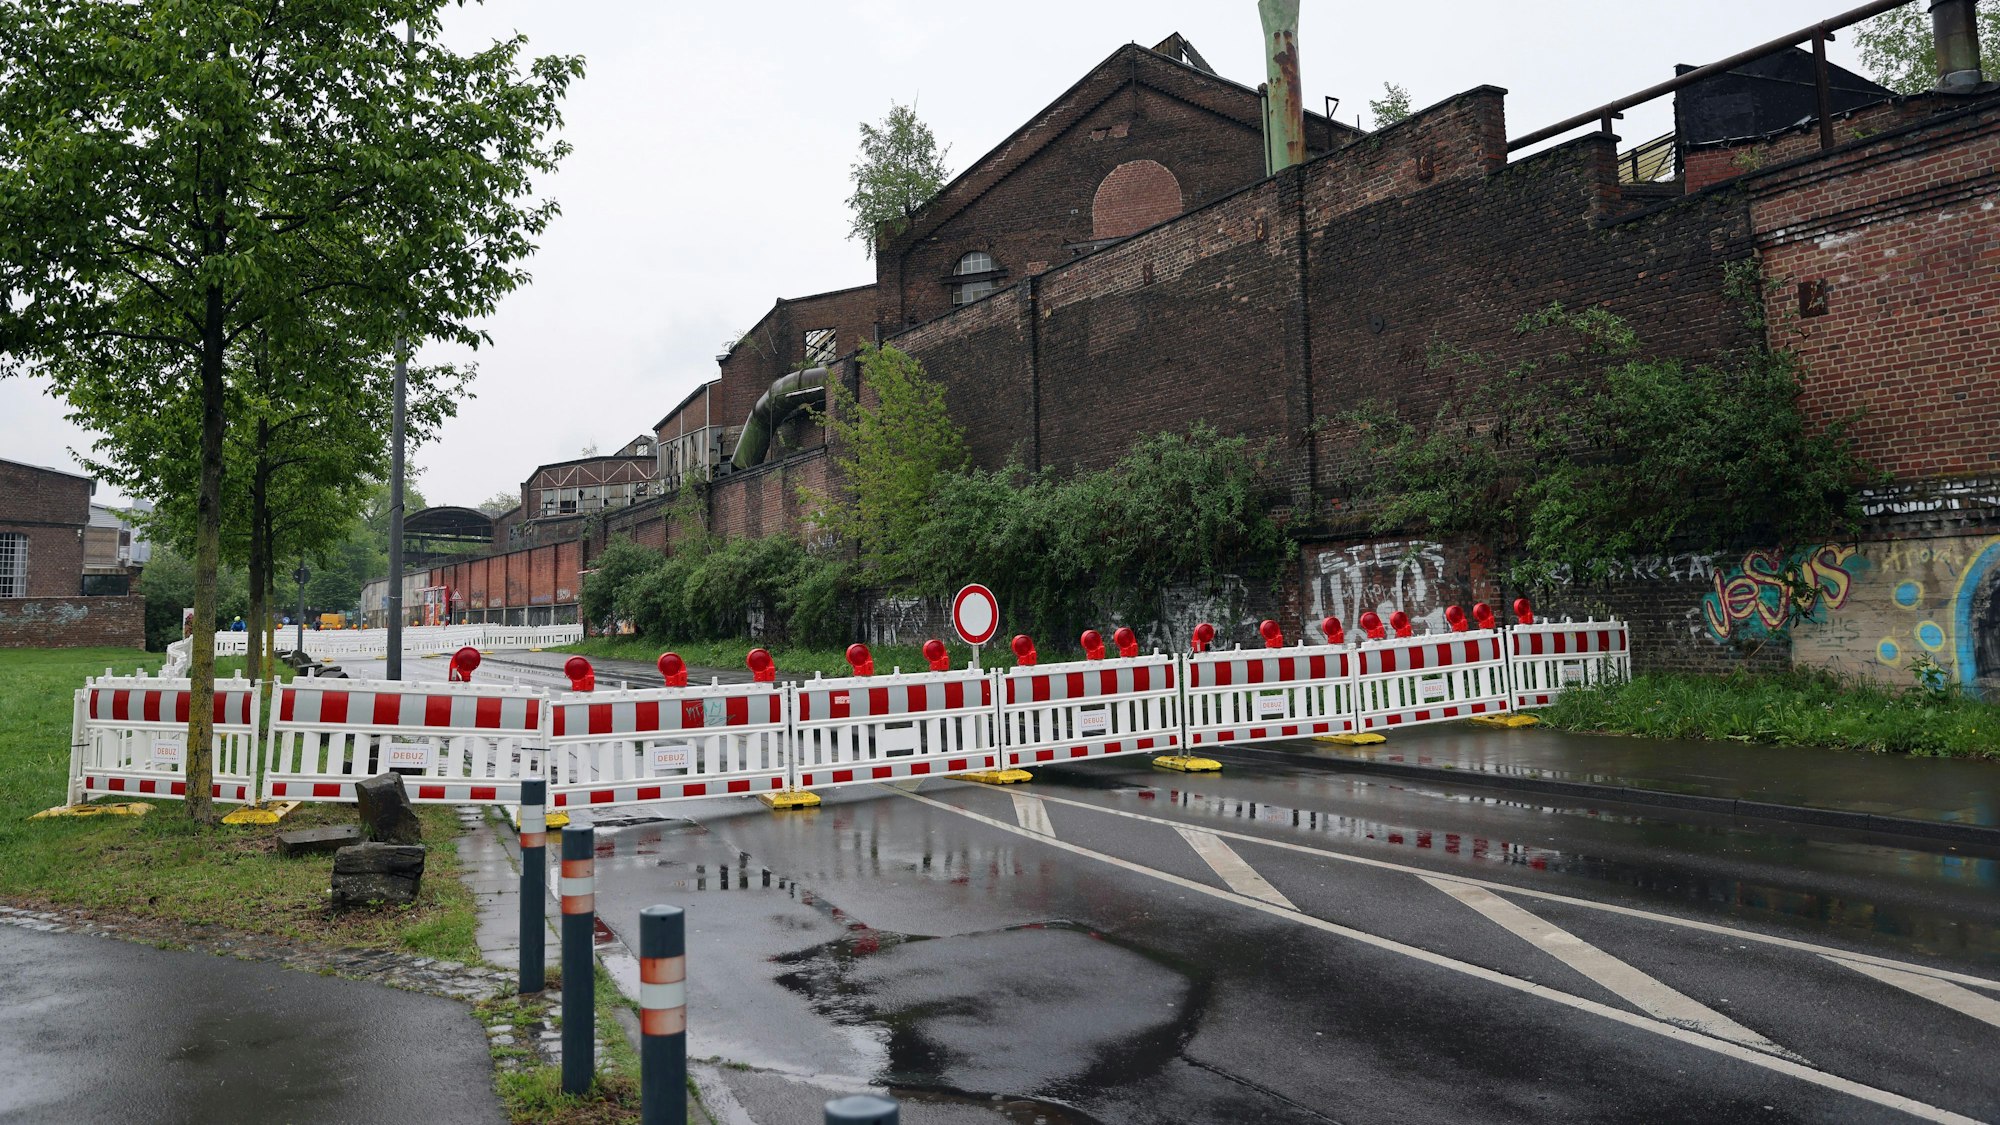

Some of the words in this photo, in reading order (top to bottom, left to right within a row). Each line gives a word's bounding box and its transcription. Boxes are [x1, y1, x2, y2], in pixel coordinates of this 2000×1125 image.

[1262, 701, 1282, 709] DEBUZ
[1083, 716, 1104, 725] DEBUZ
[156, 747, 177, 756] DEBUZ
[392, 751, 424, 760] DEBUZ
[656, 753, 685, 762] DEBUZ
